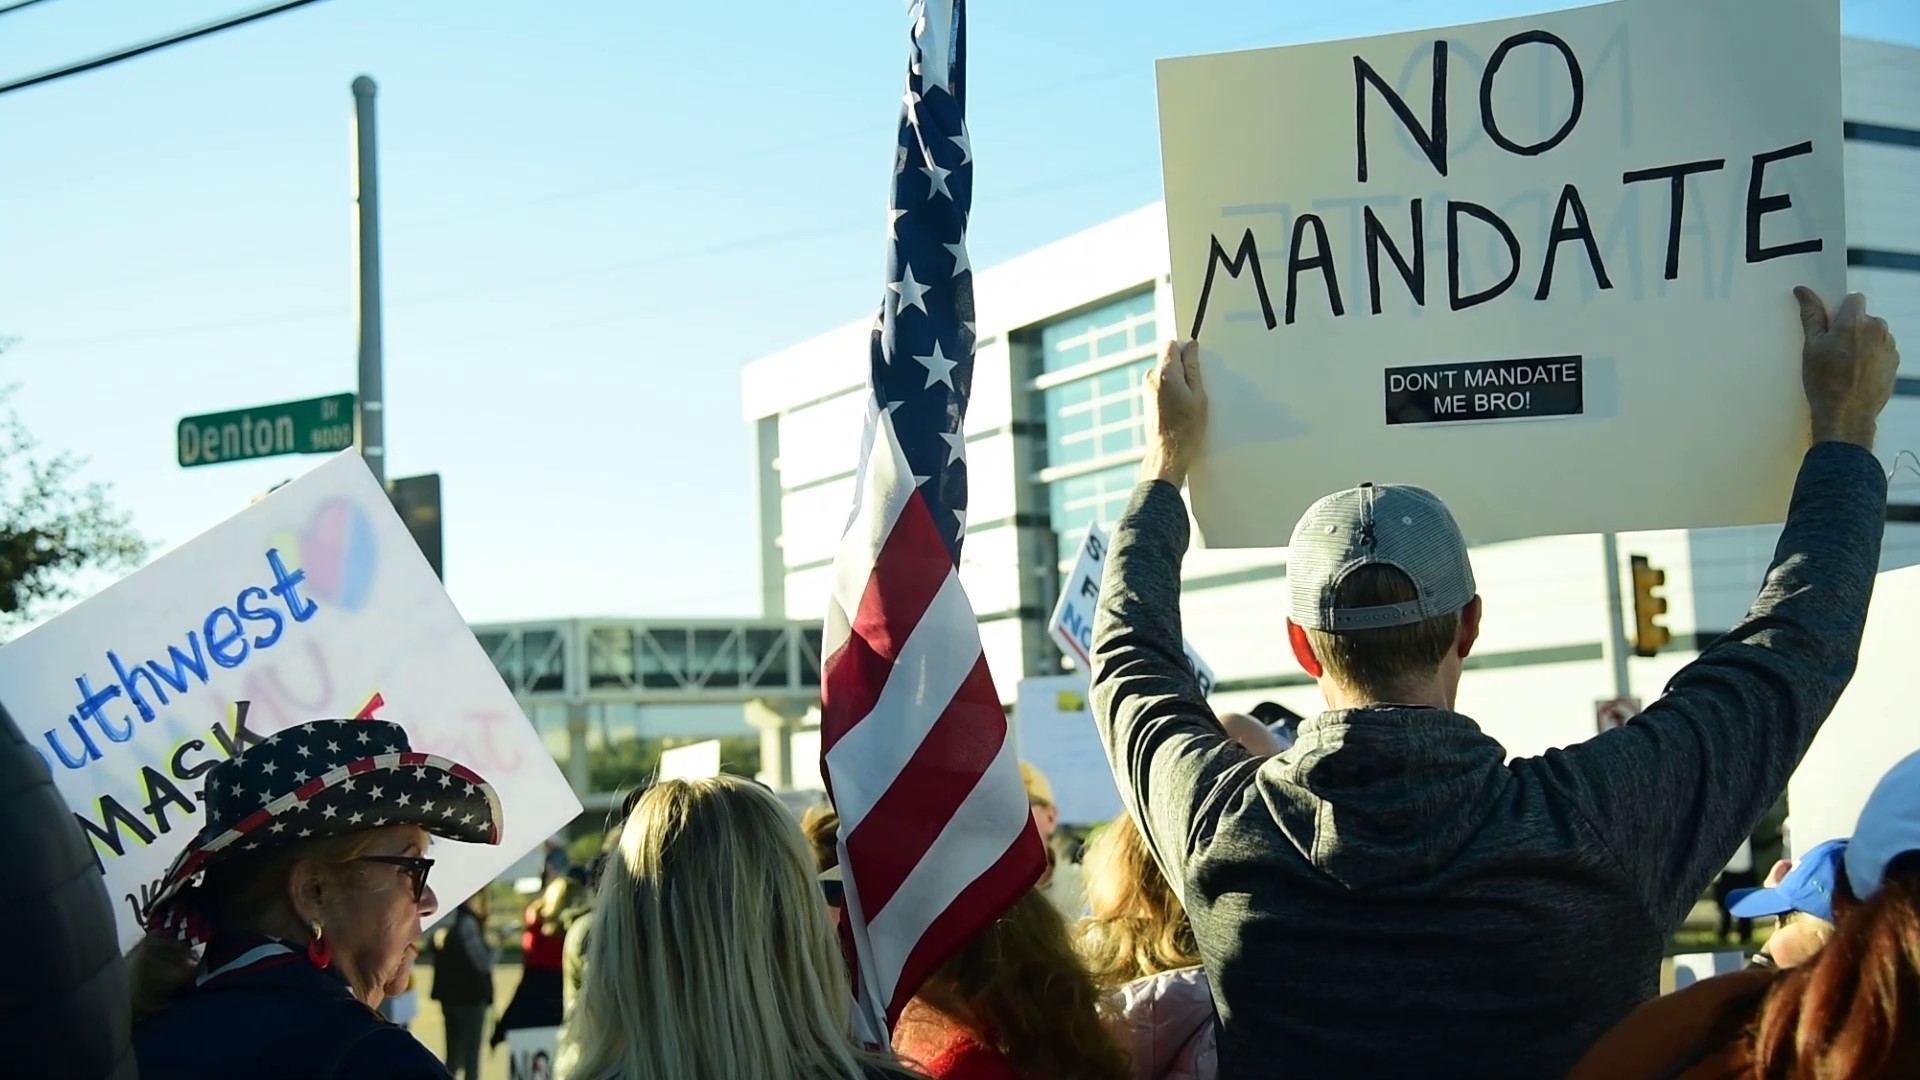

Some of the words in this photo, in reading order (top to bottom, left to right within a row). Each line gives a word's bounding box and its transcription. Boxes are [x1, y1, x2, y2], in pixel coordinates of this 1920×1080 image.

[1353, 29, 1584, 183] NO
[1190, 140, 1824, 340] MANDATE
[1434, 395, 1467, 414] ME
[1474, 391, 1531, 412] BRO!
[1464, 363, 1577, 388] MANDATE
[180, 415, 294, 465] Denton
[35, 547, 319, 778] uthwest
